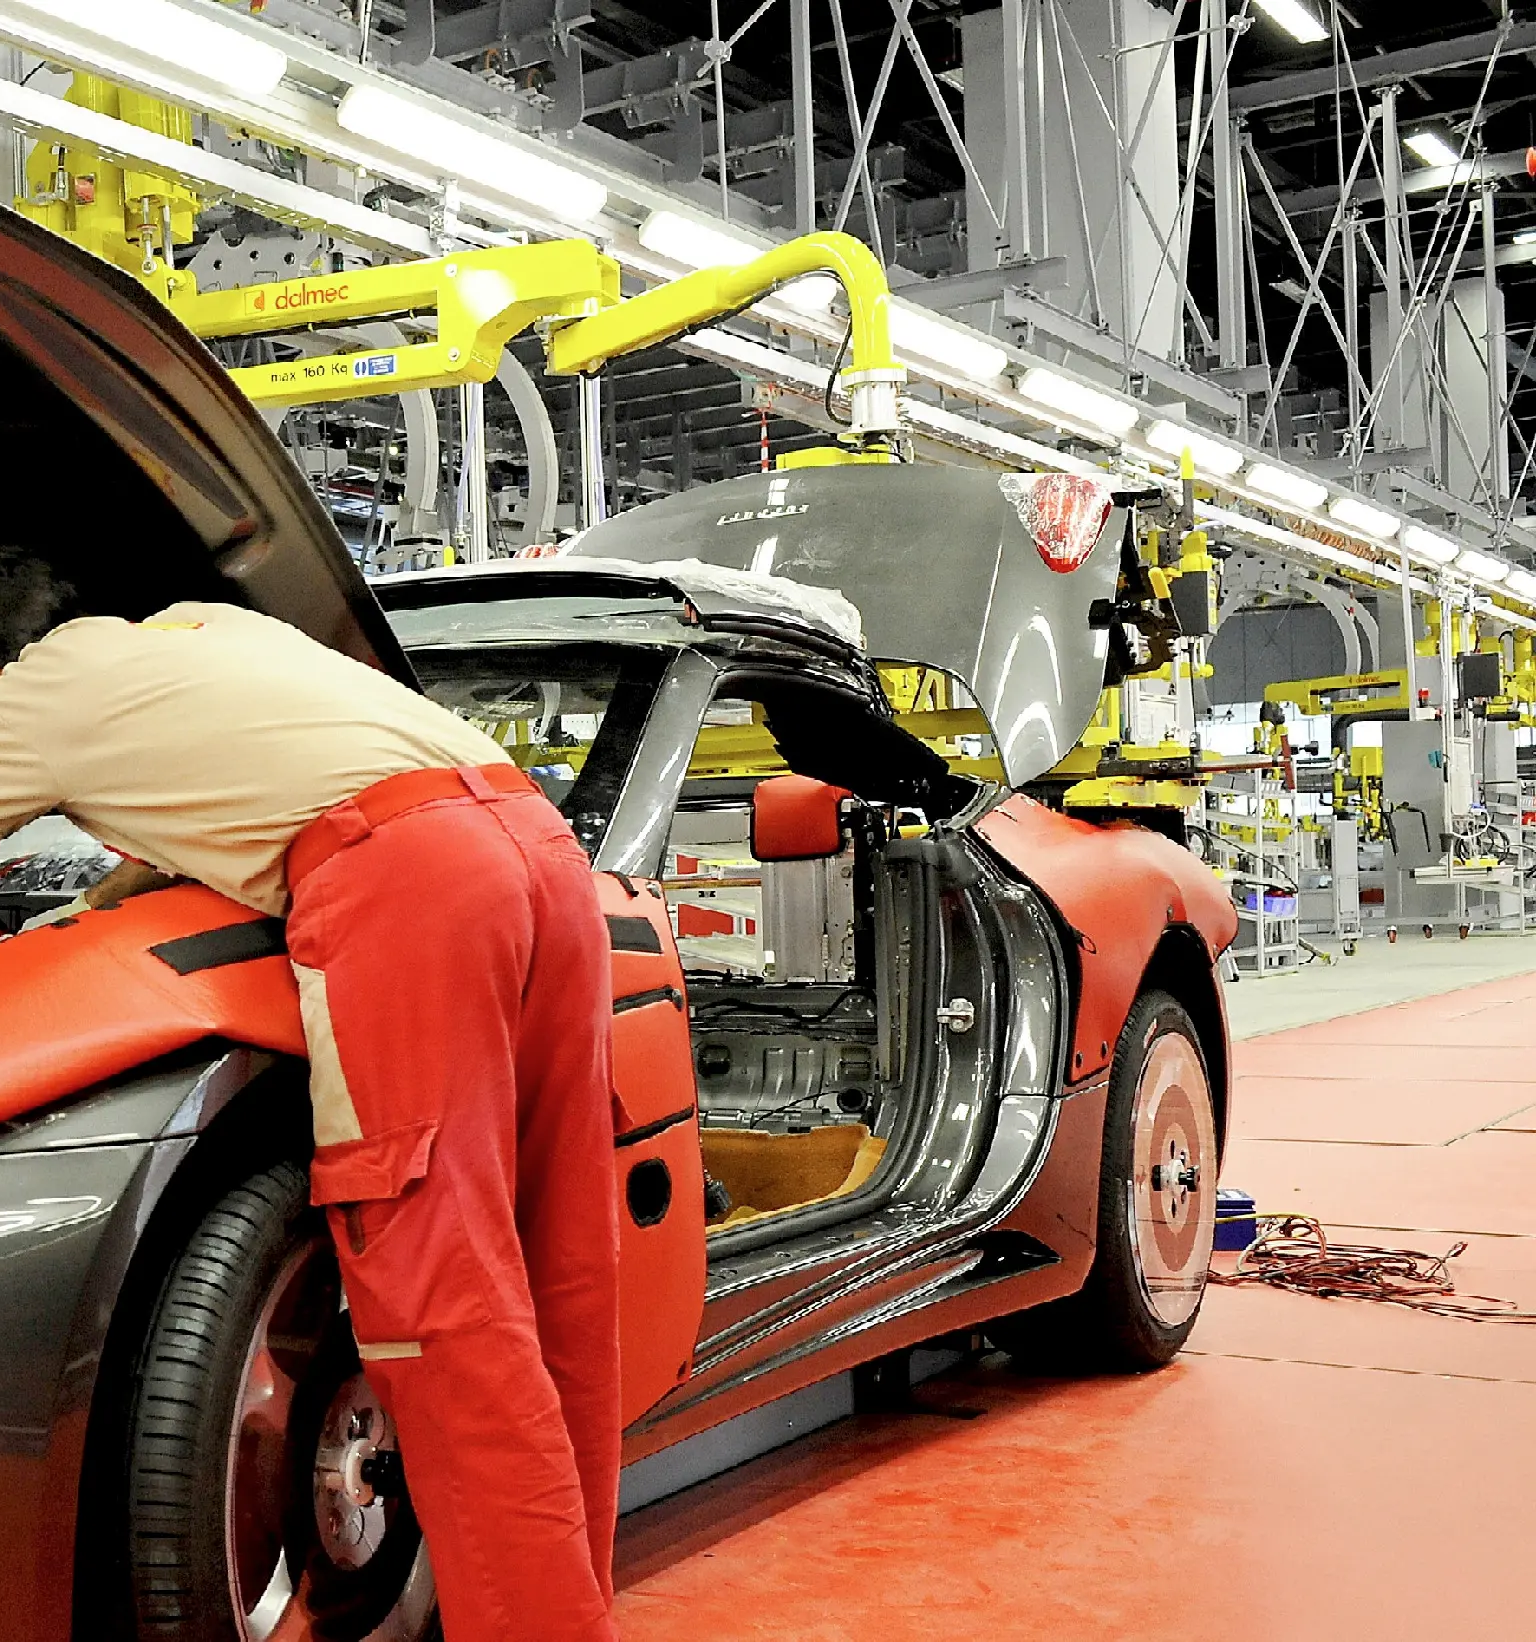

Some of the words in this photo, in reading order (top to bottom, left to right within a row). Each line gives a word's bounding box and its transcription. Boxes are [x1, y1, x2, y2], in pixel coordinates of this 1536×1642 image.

[275, 283, 349, 309] dalmec
[271, 371, 296, 382] max
[303, 364, 325, 378] 160
